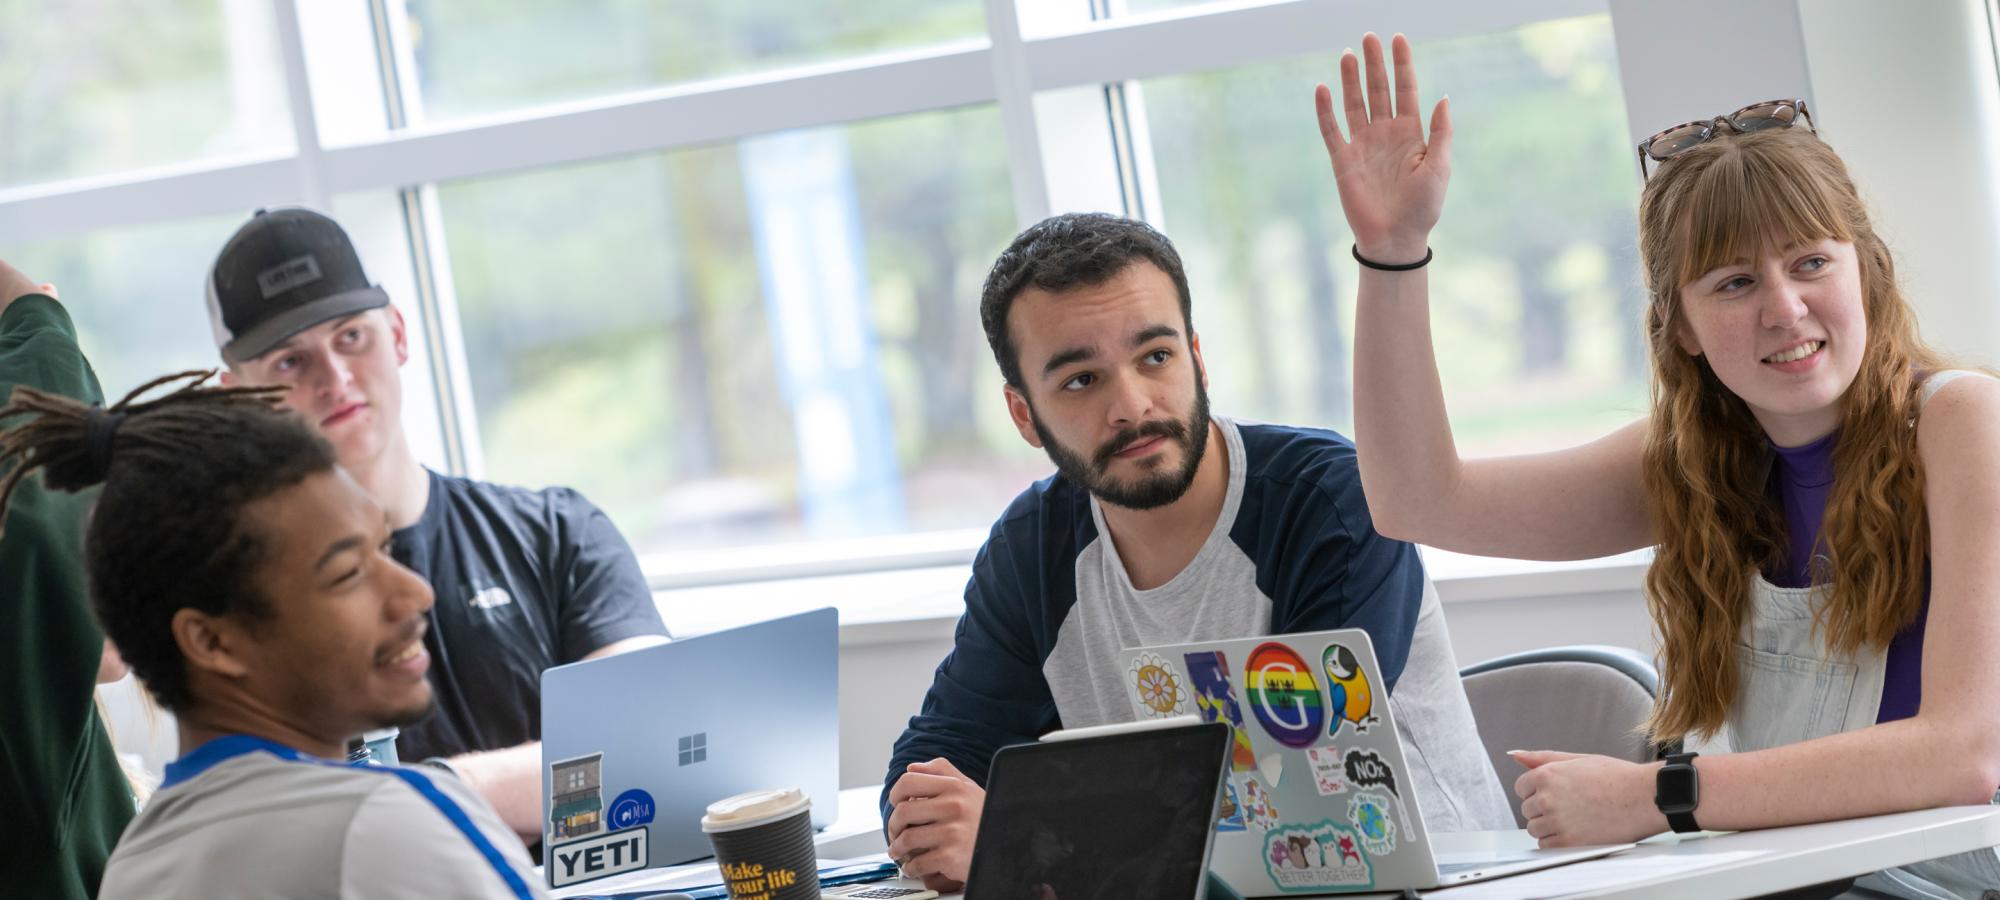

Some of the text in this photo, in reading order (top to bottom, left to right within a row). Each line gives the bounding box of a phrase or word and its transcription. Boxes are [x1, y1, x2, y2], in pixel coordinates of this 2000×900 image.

[1259, 662, 1309, 730] G
[1354, 760, 1386, 779] NOx
[558, 837, 639, 878] YETI
[721, 861, 763, 880] Make
[1280, 869, 1364, 882] BETTER TOGETHER
[731, 879, 766, 897] your
[767, 869, 796, 890] life
